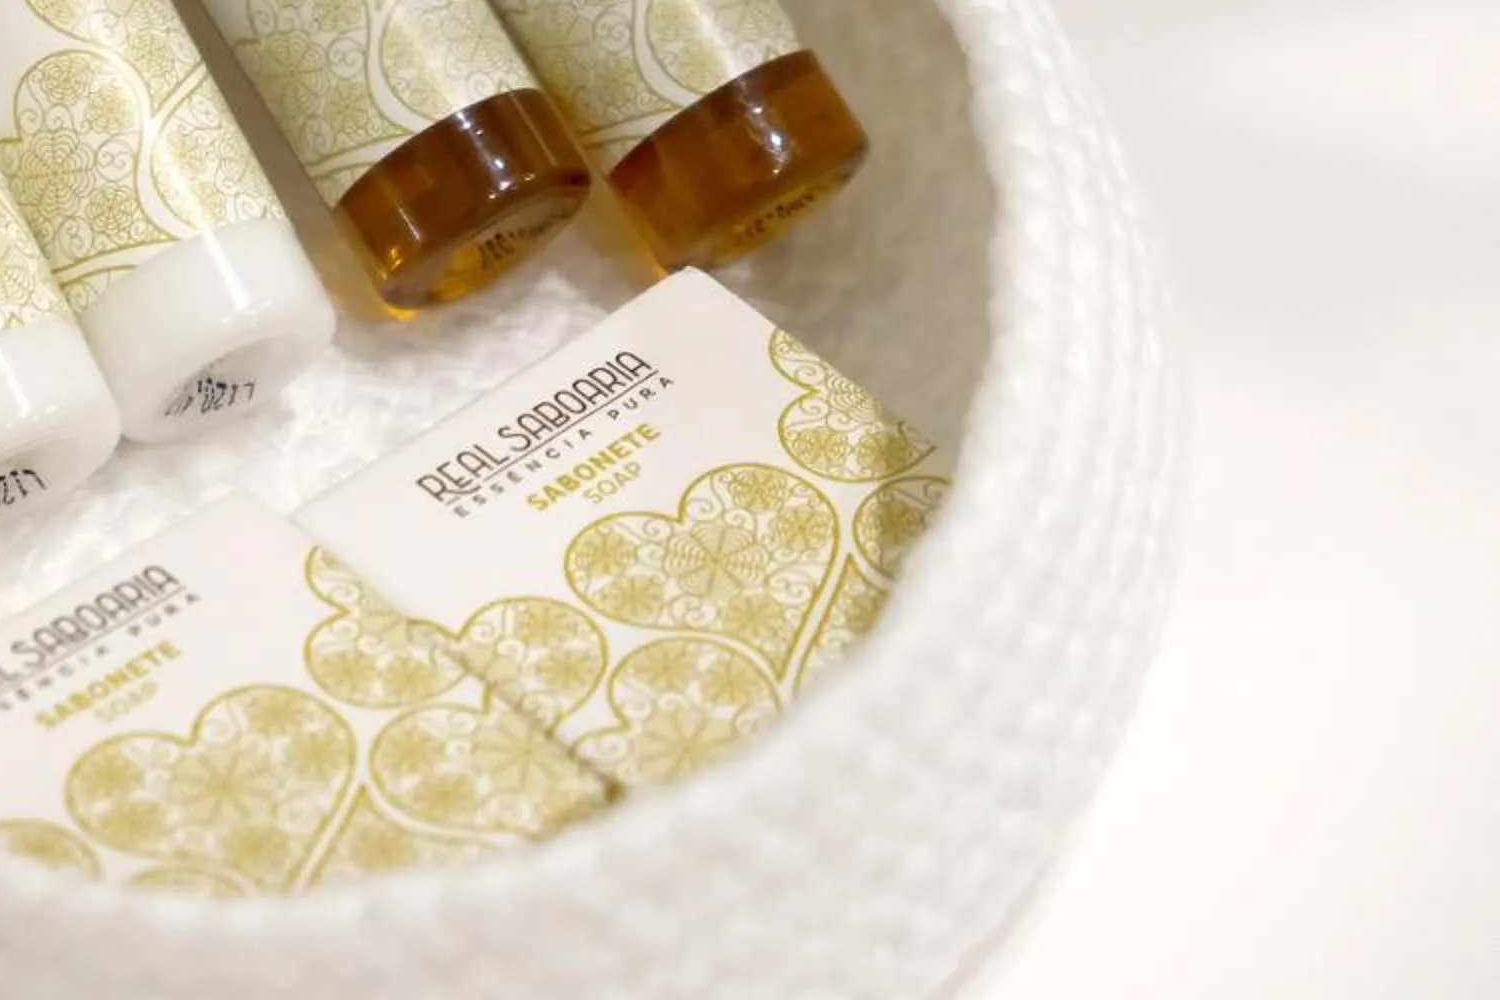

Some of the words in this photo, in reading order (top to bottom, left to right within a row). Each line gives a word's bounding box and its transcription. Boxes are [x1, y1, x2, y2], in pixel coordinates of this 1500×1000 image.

[416, 444, 510, 502] REAL
[497, 350, 653, 451] SABOARIA
[607, 376, 674, 421] PURA
[526, 423, 661, 512] SABONETE
[581, 461, 641, 504] SOAP
[11, 565, 180, 668] SABOARIA
[35, 640, 180, 728] SABONETE
